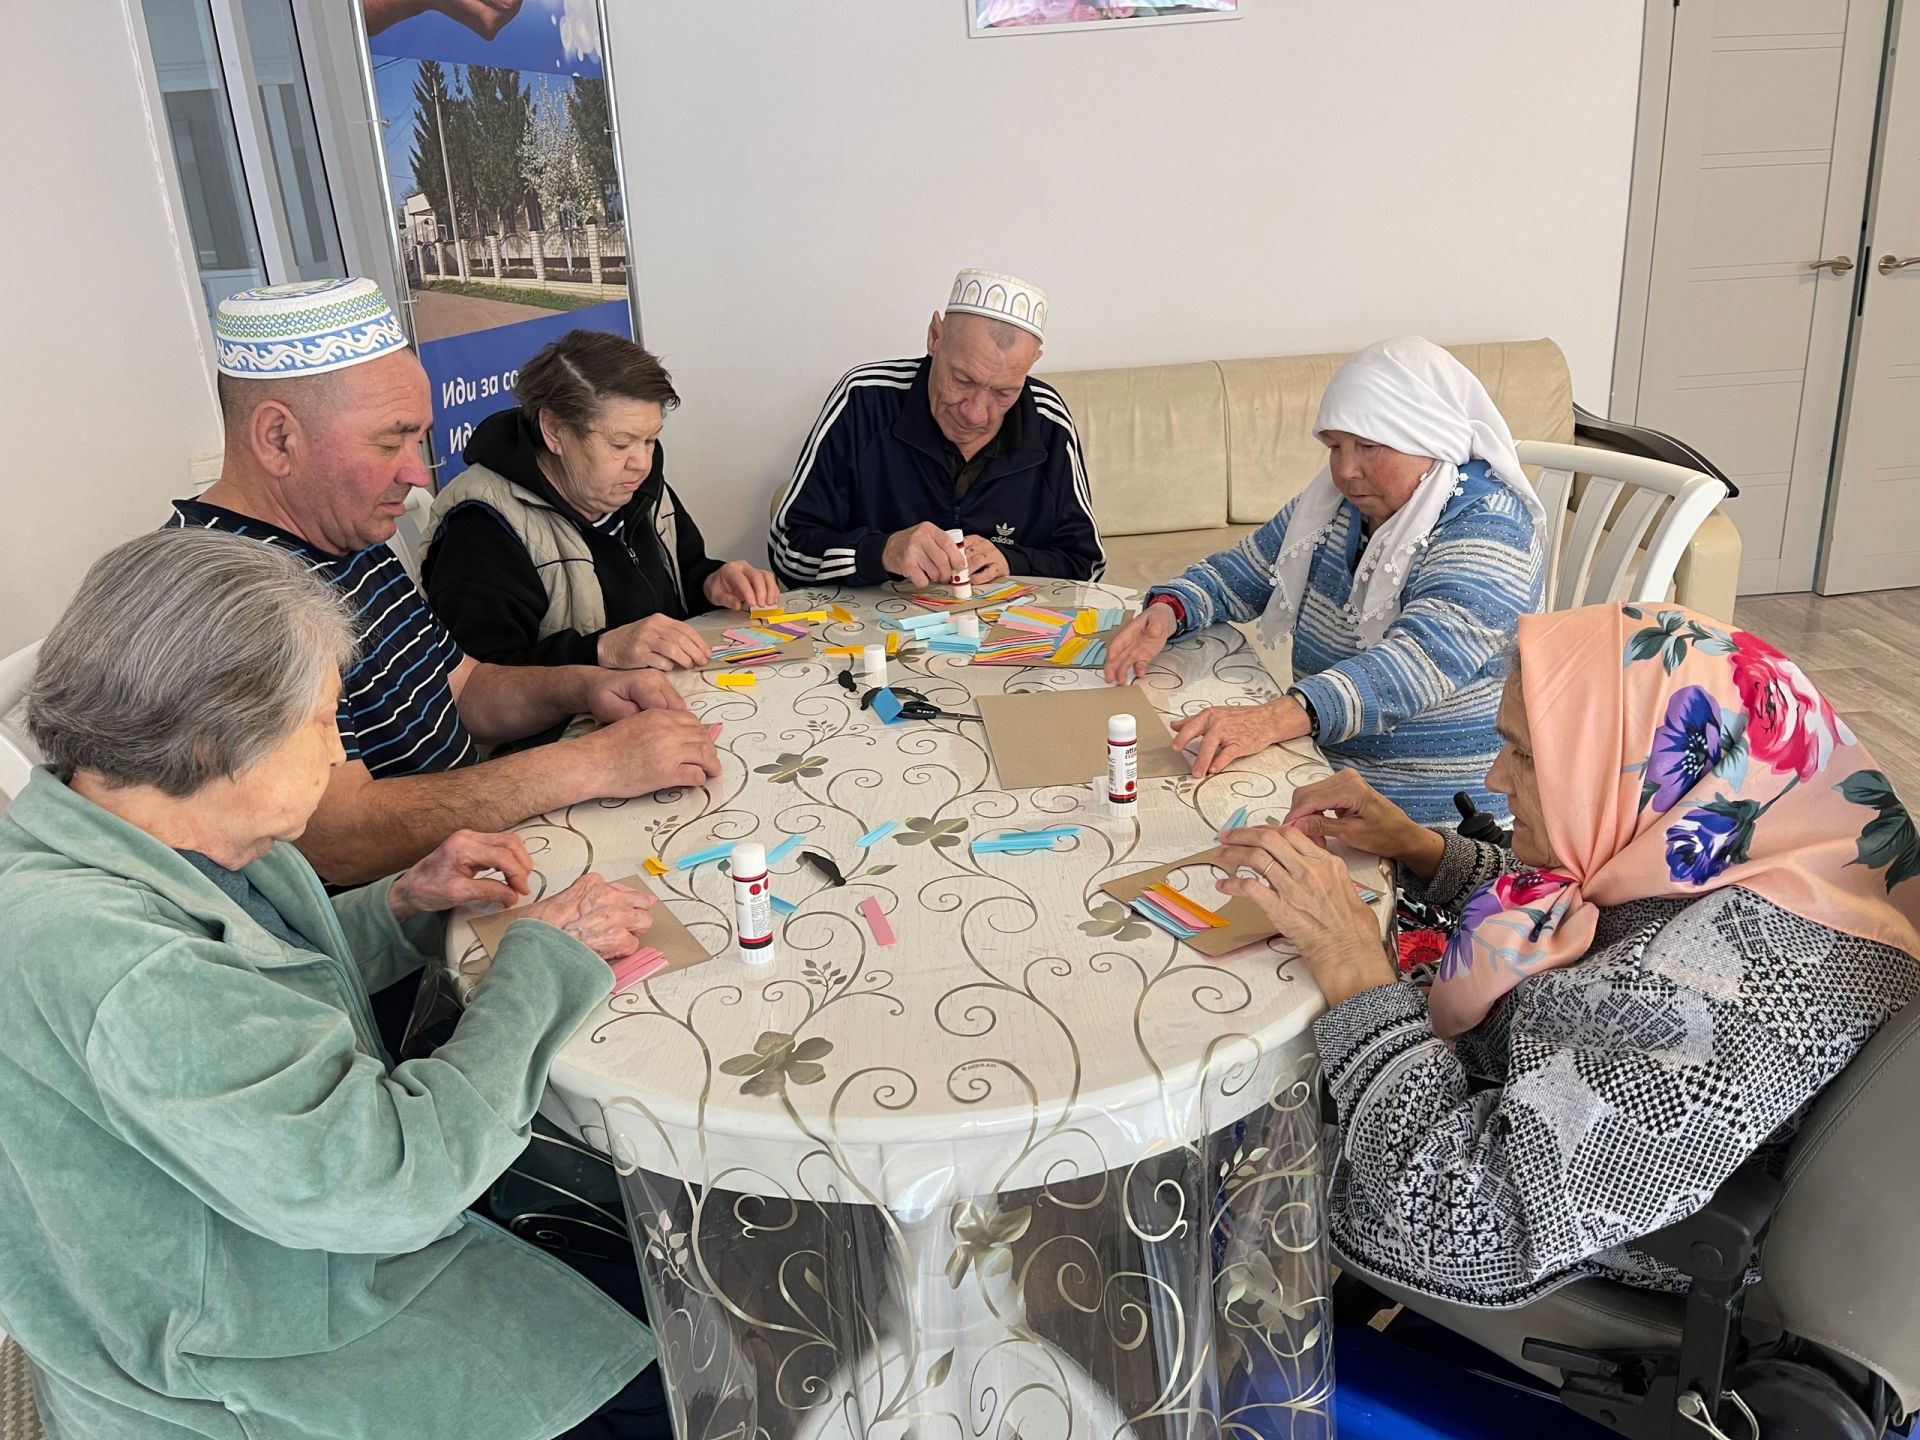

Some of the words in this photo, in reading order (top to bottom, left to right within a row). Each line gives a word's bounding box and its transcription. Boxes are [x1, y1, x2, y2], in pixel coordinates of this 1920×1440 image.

[442, 377, 477, 409] Иди
[481, 374, 499, 398] за
[449, 422, 477, 455] Ид
[990, 536, 1015, 545] adidas
